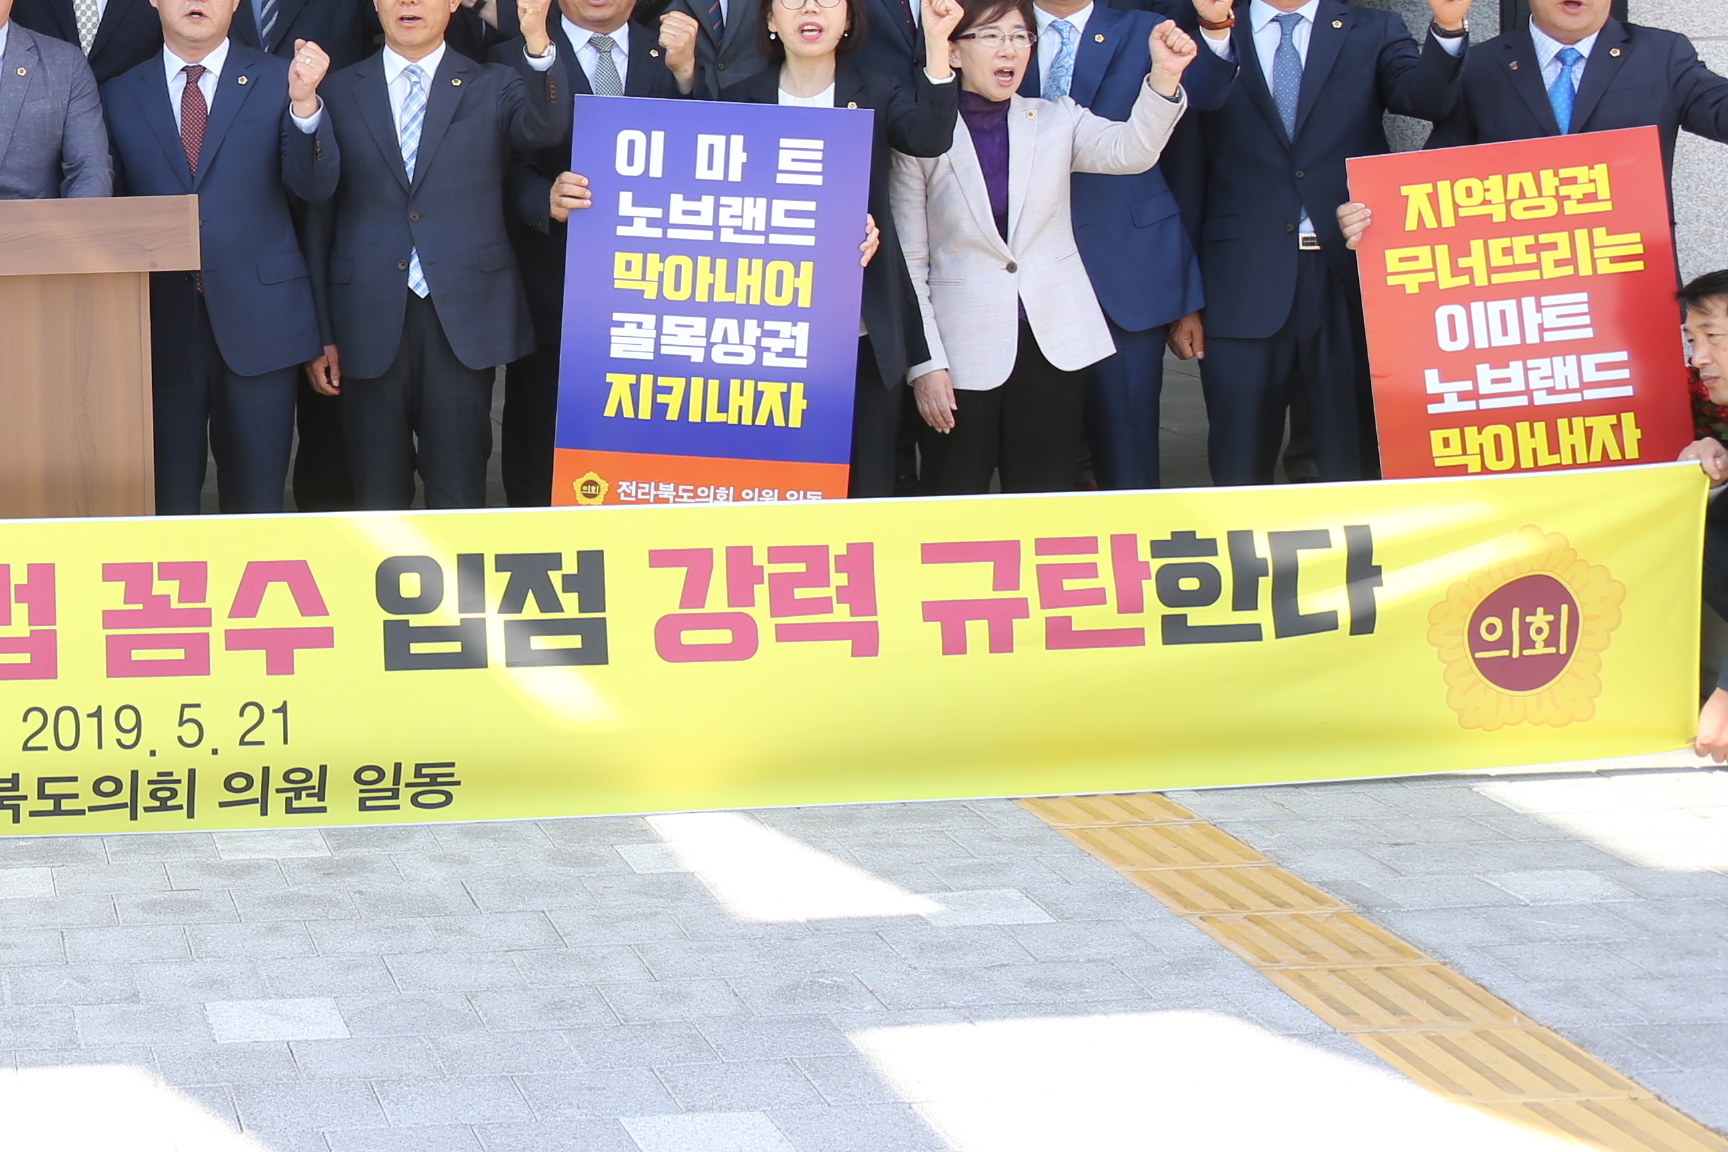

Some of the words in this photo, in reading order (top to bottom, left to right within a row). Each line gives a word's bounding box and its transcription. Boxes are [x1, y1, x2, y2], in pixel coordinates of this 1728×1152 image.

[616, 191, 817, 246] 노브랜드
[1400, 163, 1613, 231] 지역상권
[613, 252, 814, 308] 막아내어
[1384, 227, 1645, 294] 무너뜨리는
[610, 312, 809, 368] 골목상권
[1434, 292, 1594, 352] 이마트
[603, 373, 808, 428] 지키내자
[1424, 351, 1634, 414] 노브랜드
[1430, 412, 1642, 473] 막아내자
[582, 485, 599, 494] 의회
[617, 481, 734, 503] 전라북도의회
[102, 560, 334, 679] 꼼수
[375, 550, 609, 671] 입점
[648, 542, 880, 663] 강력
[920, 524, 1383, 656] 규탄한다
[1474, 603, 1569, 659] 의회
[22, 704, 157, 758] 2019.
[177, 702, 219, 756] 5.
[239, 699, 290, 748] 21
[218, 763, 329, 817] 의원
[352, 761, 462, 812] 일동
